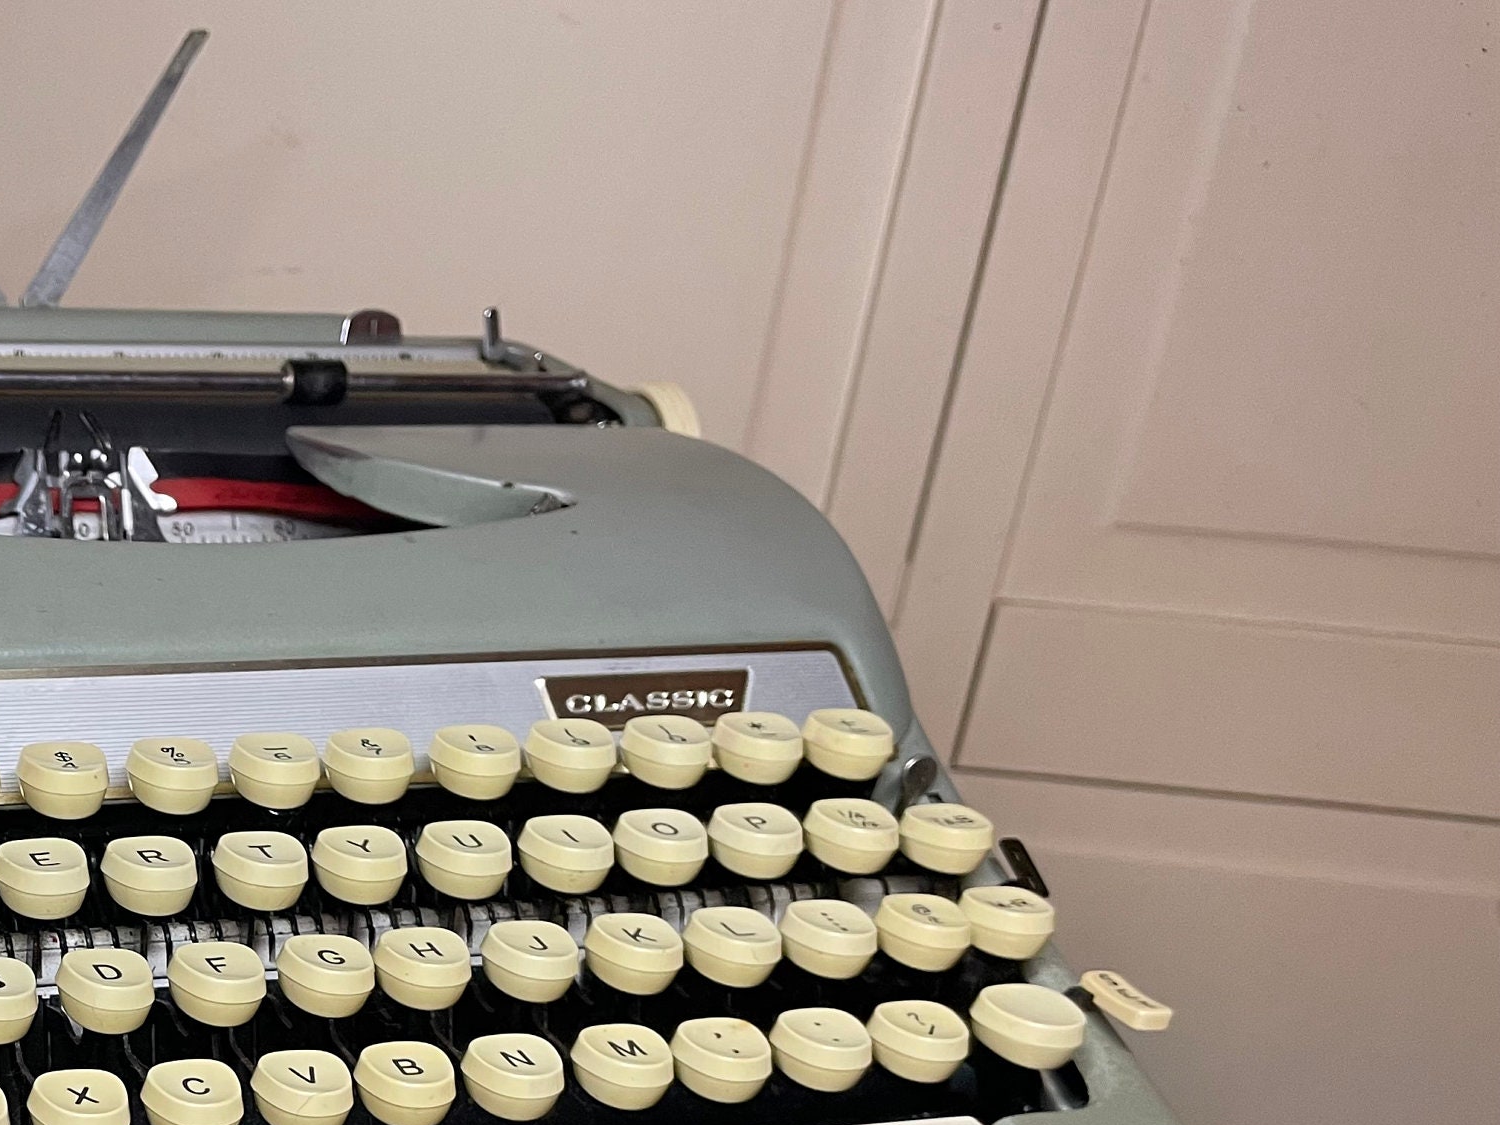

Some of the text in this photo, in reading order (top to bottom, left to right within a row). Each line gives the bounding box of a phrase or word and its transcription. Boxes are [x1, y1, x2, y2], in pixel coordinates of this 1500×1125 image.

[565, 689, 734, 714] CLASSIC
[53, 751, 74, 765] $
[160, 746, 185, 761] %
[273, 752, 293, 760] 6
[651, 822, 679, 836] O
[744, 816, 767, 830] P
[452, 834, 483, 849] U
[561, 829, 580, 843] I
[247, 844, 273, 859] T
[346, 839, 372, 853] Y
[28, 851, 61, 867] E
[136, 849, 170, 864] R
[621, 927, 657, 943] K
[720, 922, 756, 937] L
[409, 941, 444, 958] H
[528, 935, 549, 951] J
[204, 956, 227, 974] F
[317, 949, 346, 965] G
[91, 964, 123, 980] D
[607, 1039, 648, 1057] M
[499, 1049, 536, 1068] N
[287, 1066, 316, 1084] V
[391, 1058, 425, 1076] B
[181, 1077, 211, 1096] C
[66, 1086, 100, 1105] X
